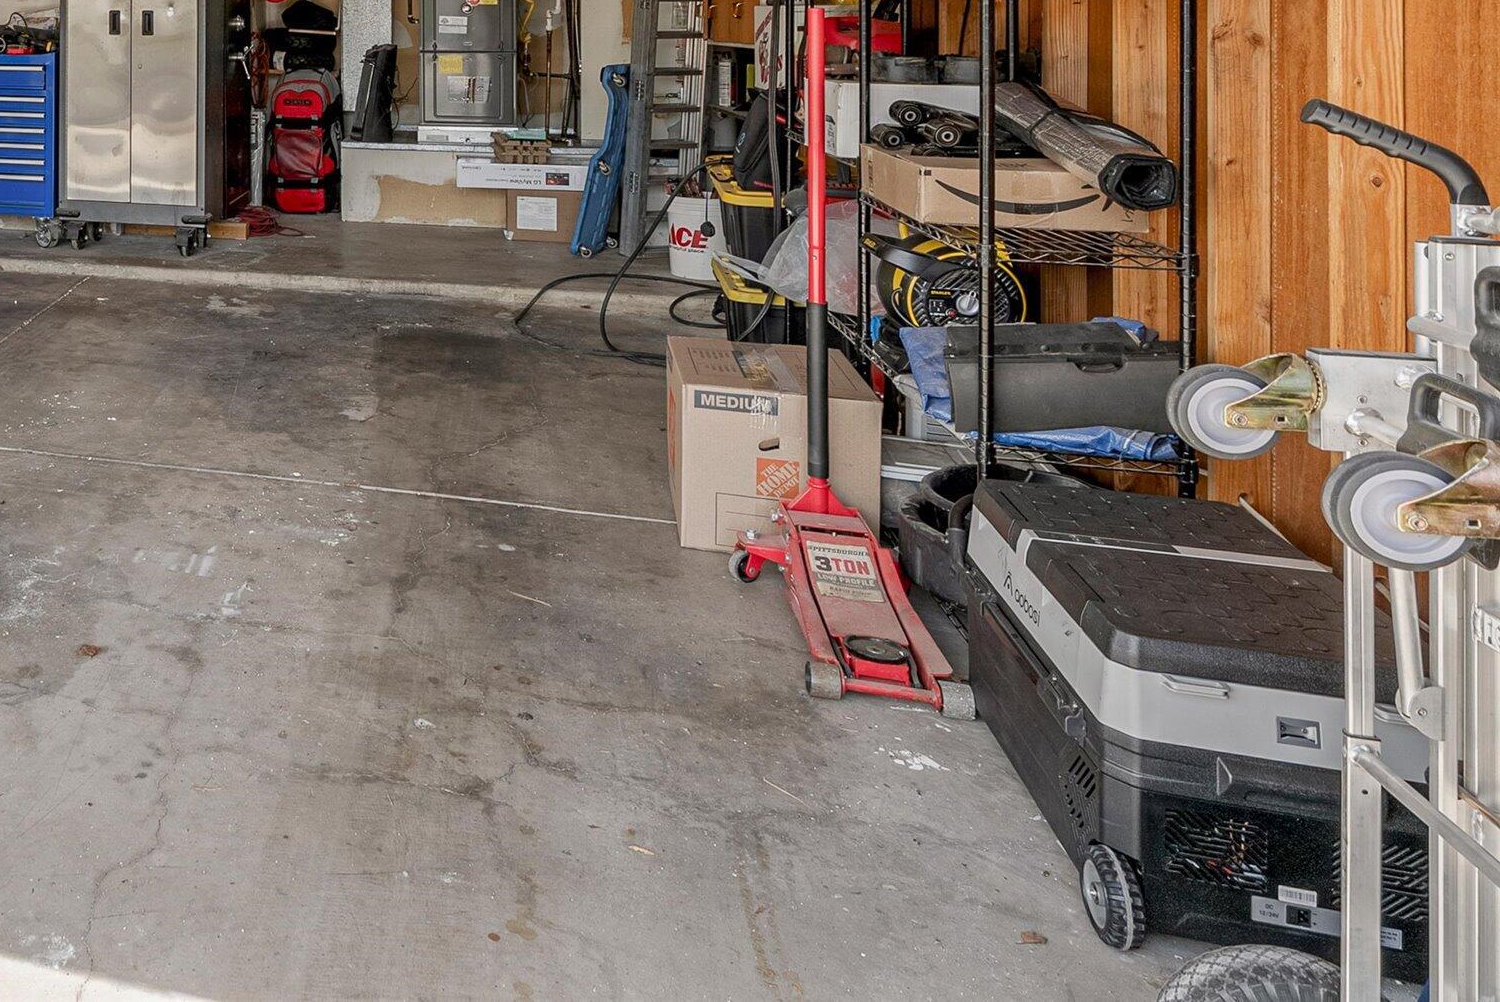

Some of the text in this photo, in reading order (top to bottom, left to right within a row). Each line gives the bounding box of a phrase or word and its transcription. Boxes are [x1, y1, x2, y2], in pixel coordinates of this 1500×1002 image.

[757, 460, 799, 497] HOME
[761, 463, 779, 477] THE
[773, 477, 799, 499] DEPOT
